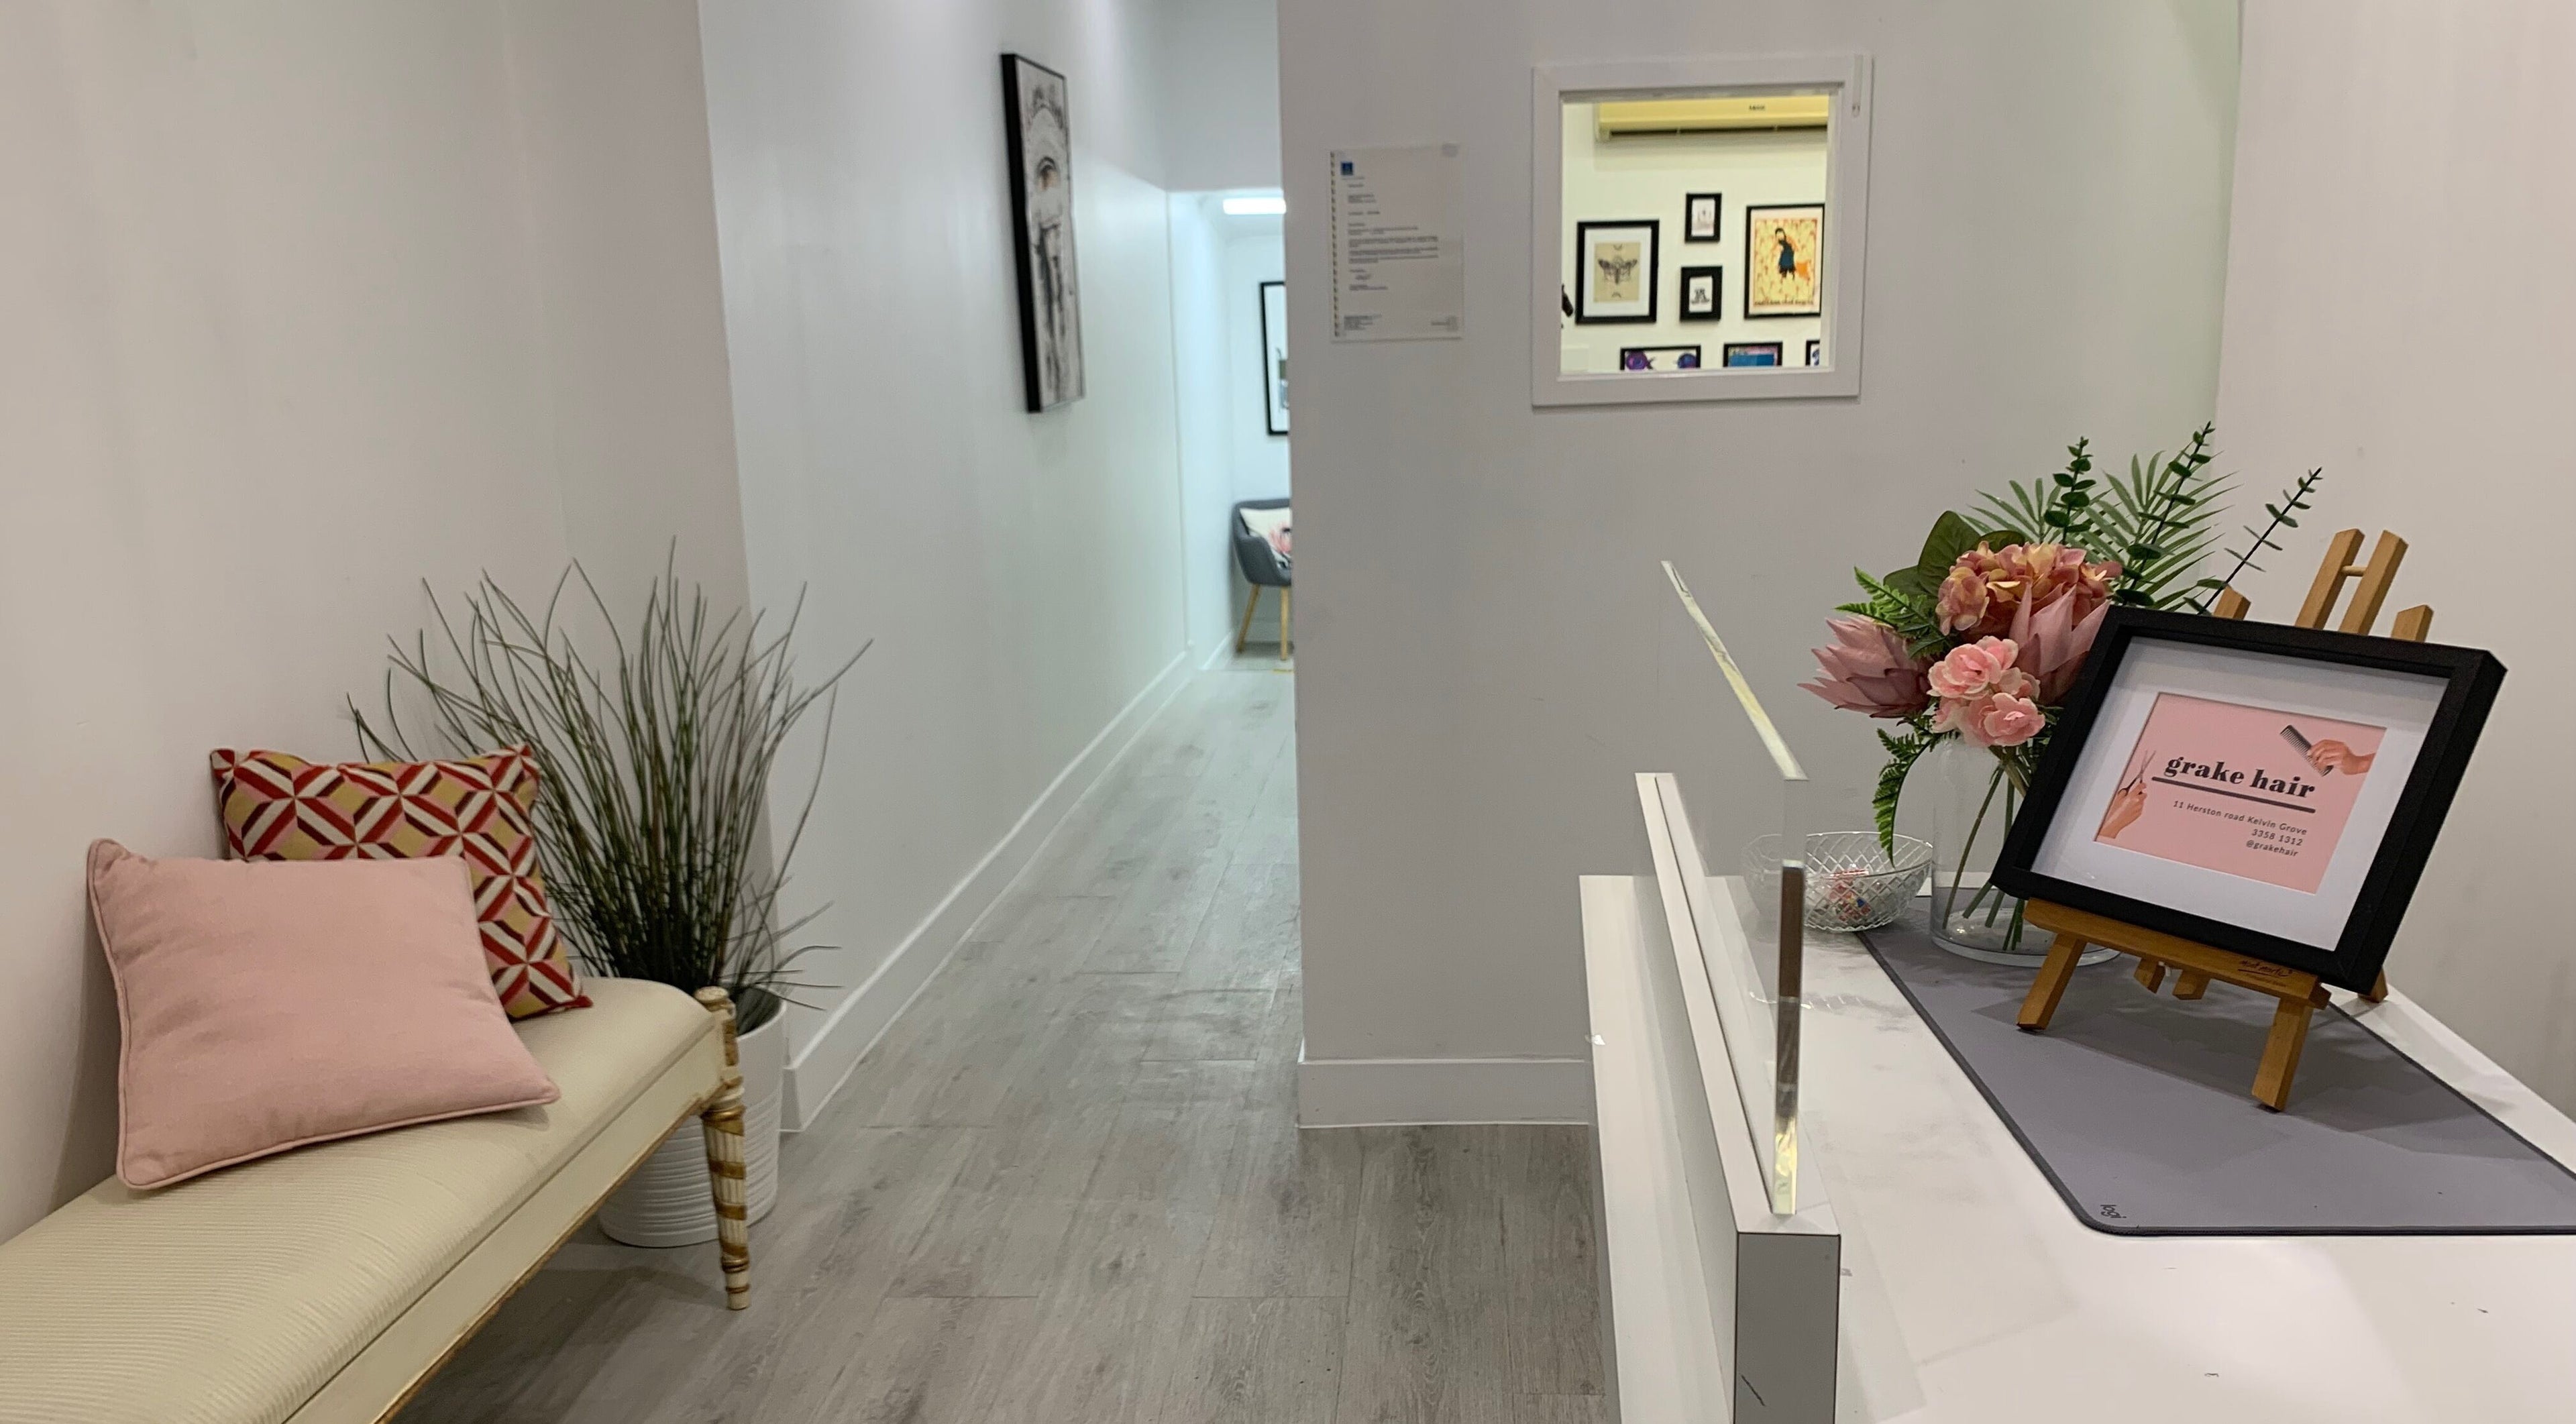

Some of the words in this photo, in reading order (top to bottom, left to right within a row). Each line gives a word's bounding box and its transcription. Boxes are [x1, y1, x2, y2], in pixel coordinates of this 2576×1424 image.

[2164, 757, 2245, 784] grake
[2249, 769, 2315, 798] hair
[2174, 800, 2184, 808] 11
[2187, 803, 2222, 816] Herston
[2224, 812, 2245, 821] road
[2247, 816, 2276, 828] Kelvin
[2279, 823, 2307, 835] Grove
[2246, 840, 2298, 857] @grakehair
[2252, 828, 2275, 840] 3358
[2279, 835, 2303, 846] 1312
